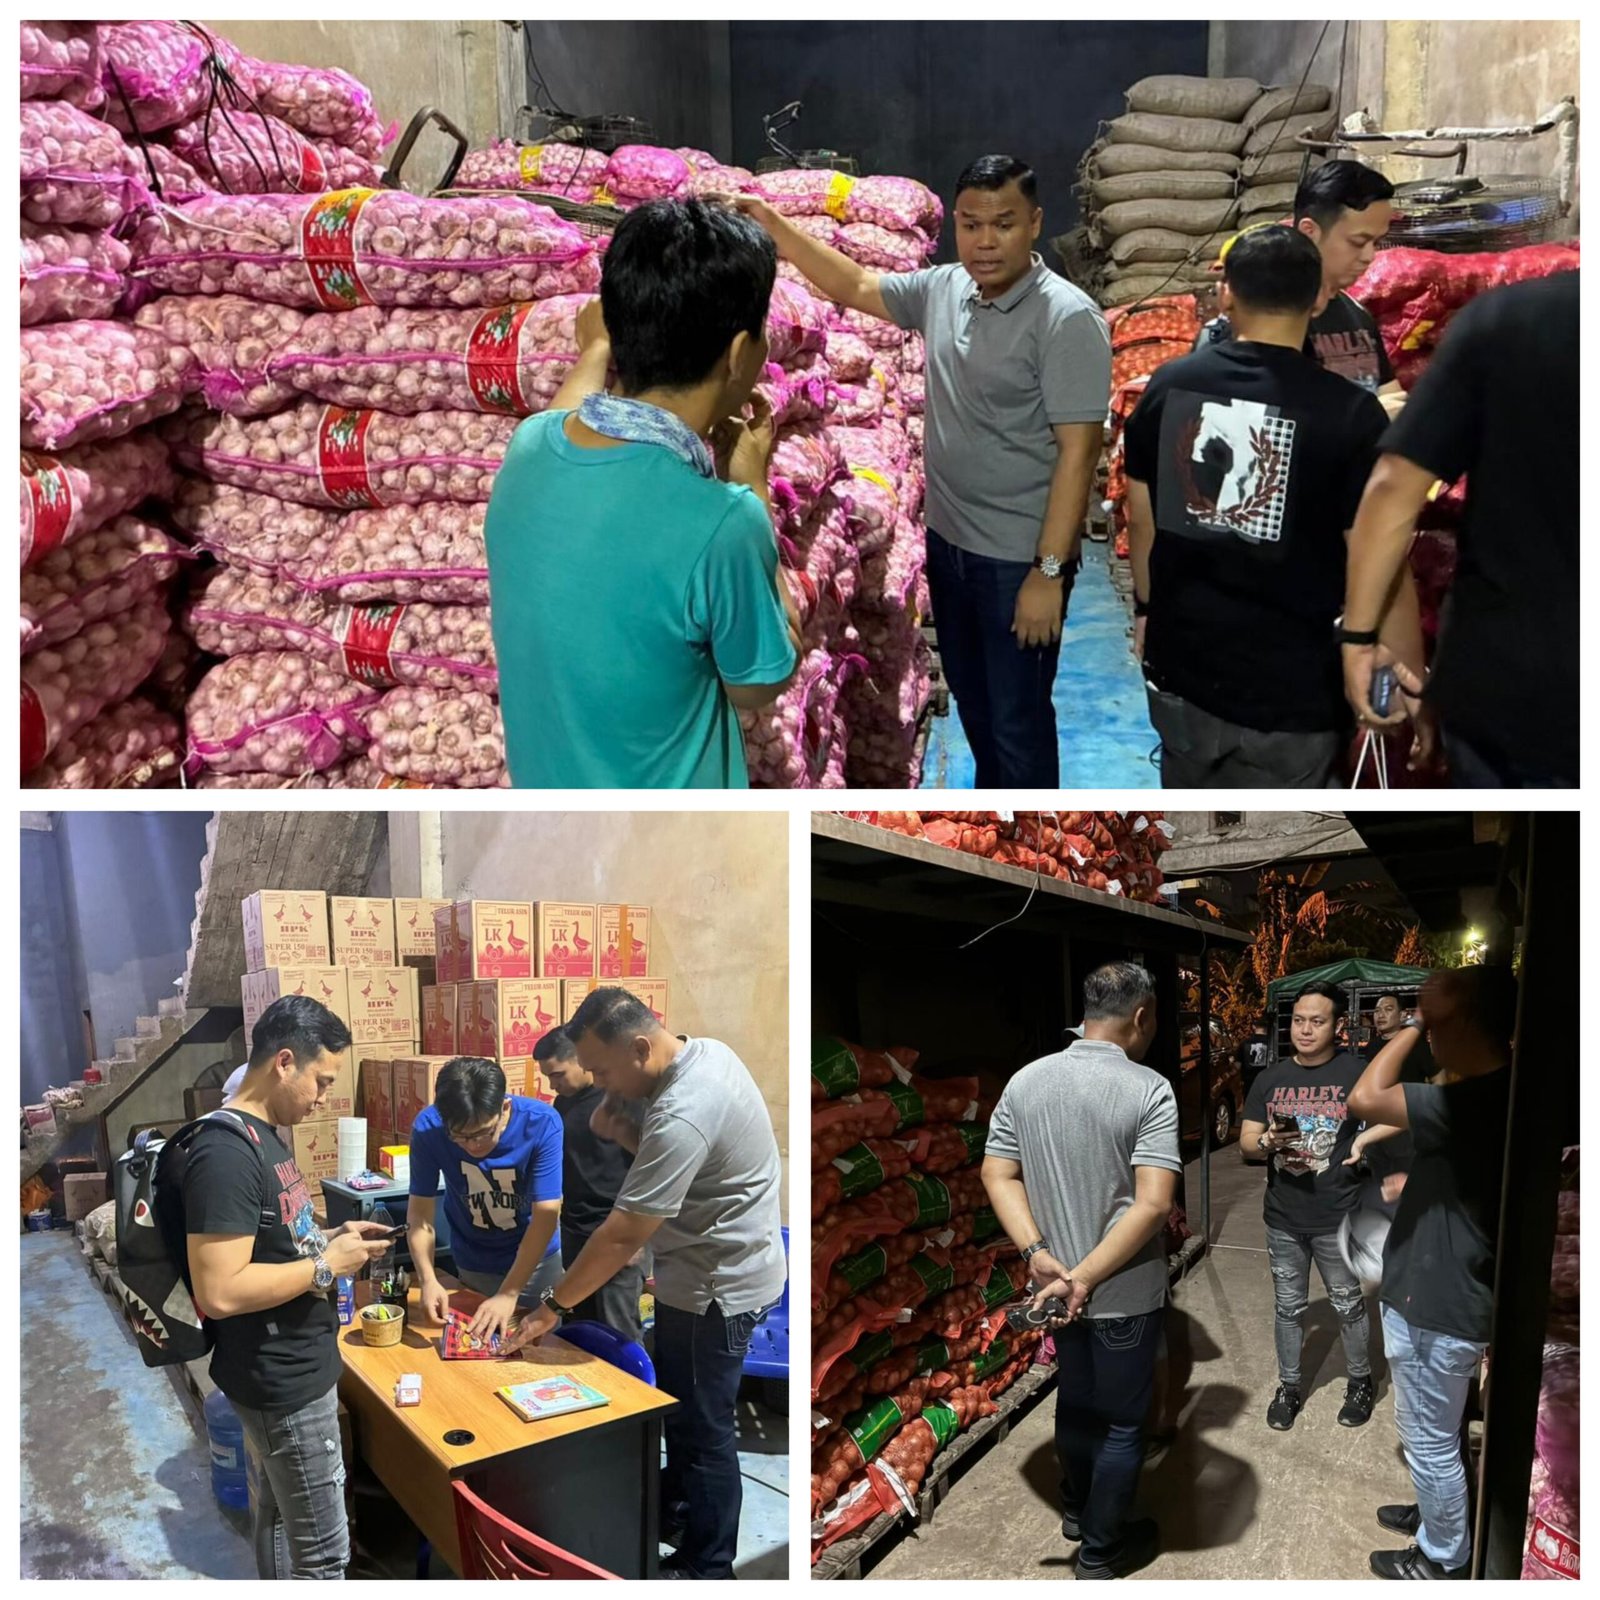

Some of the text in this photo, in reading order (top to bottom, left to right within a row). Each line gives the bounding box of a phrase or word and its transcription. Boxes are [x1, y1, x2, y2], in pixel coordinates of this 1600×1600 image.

[484, 928, 502, 942] LK
[552, 928, 568, 942] LK
[265, 943, 306, 951] SUPER 150
[509, 1005, 528, 1019] LK
[353, 1018, 378, 1026] SUPER
[1272, 1085, 1346, 1102] HARLEY-
[460, 1160, 518, 1231] N
